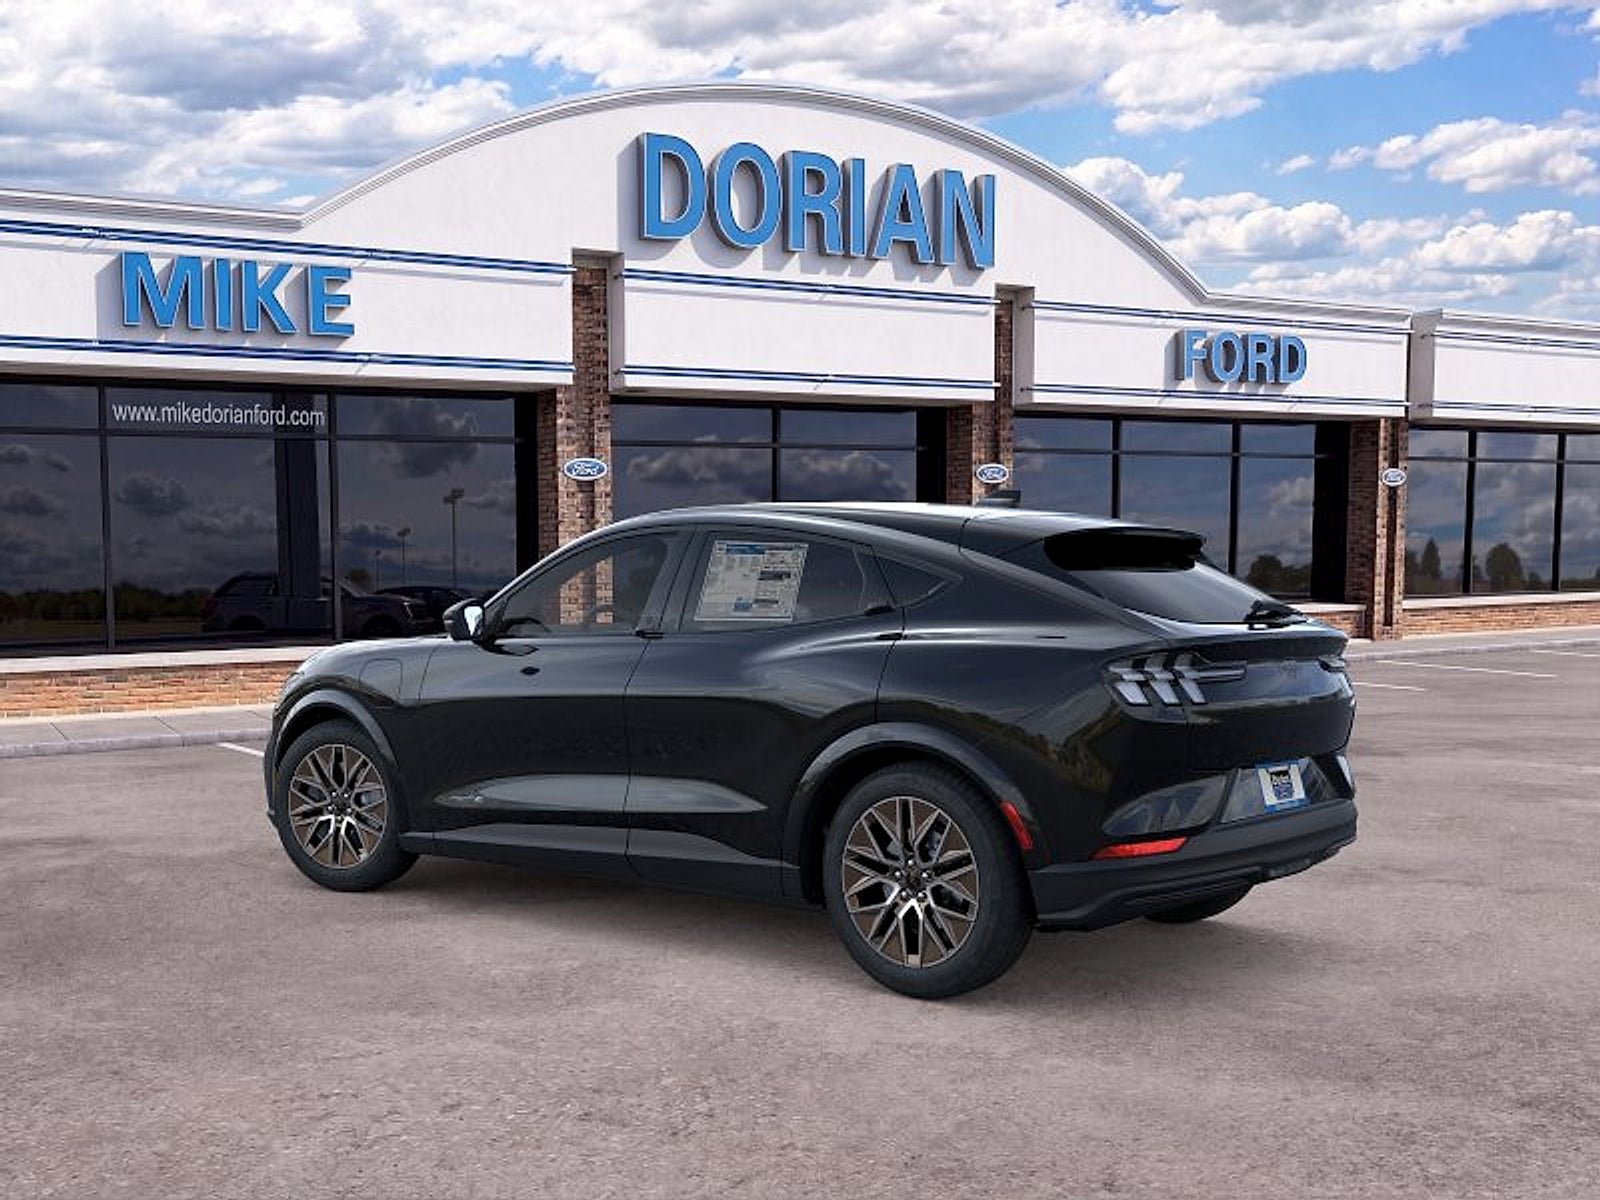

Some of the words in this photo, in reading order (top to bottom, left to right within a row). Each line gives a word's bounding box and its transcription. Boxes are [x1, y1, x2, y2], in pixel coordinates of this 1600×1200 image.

[640, 132, 995, 270] DORIAN
[121, 251, 354, 337] MIKE
[1176, 328, 1307, 384] FORD
[112, 402, 326, 427] www.mikedorianford.com
